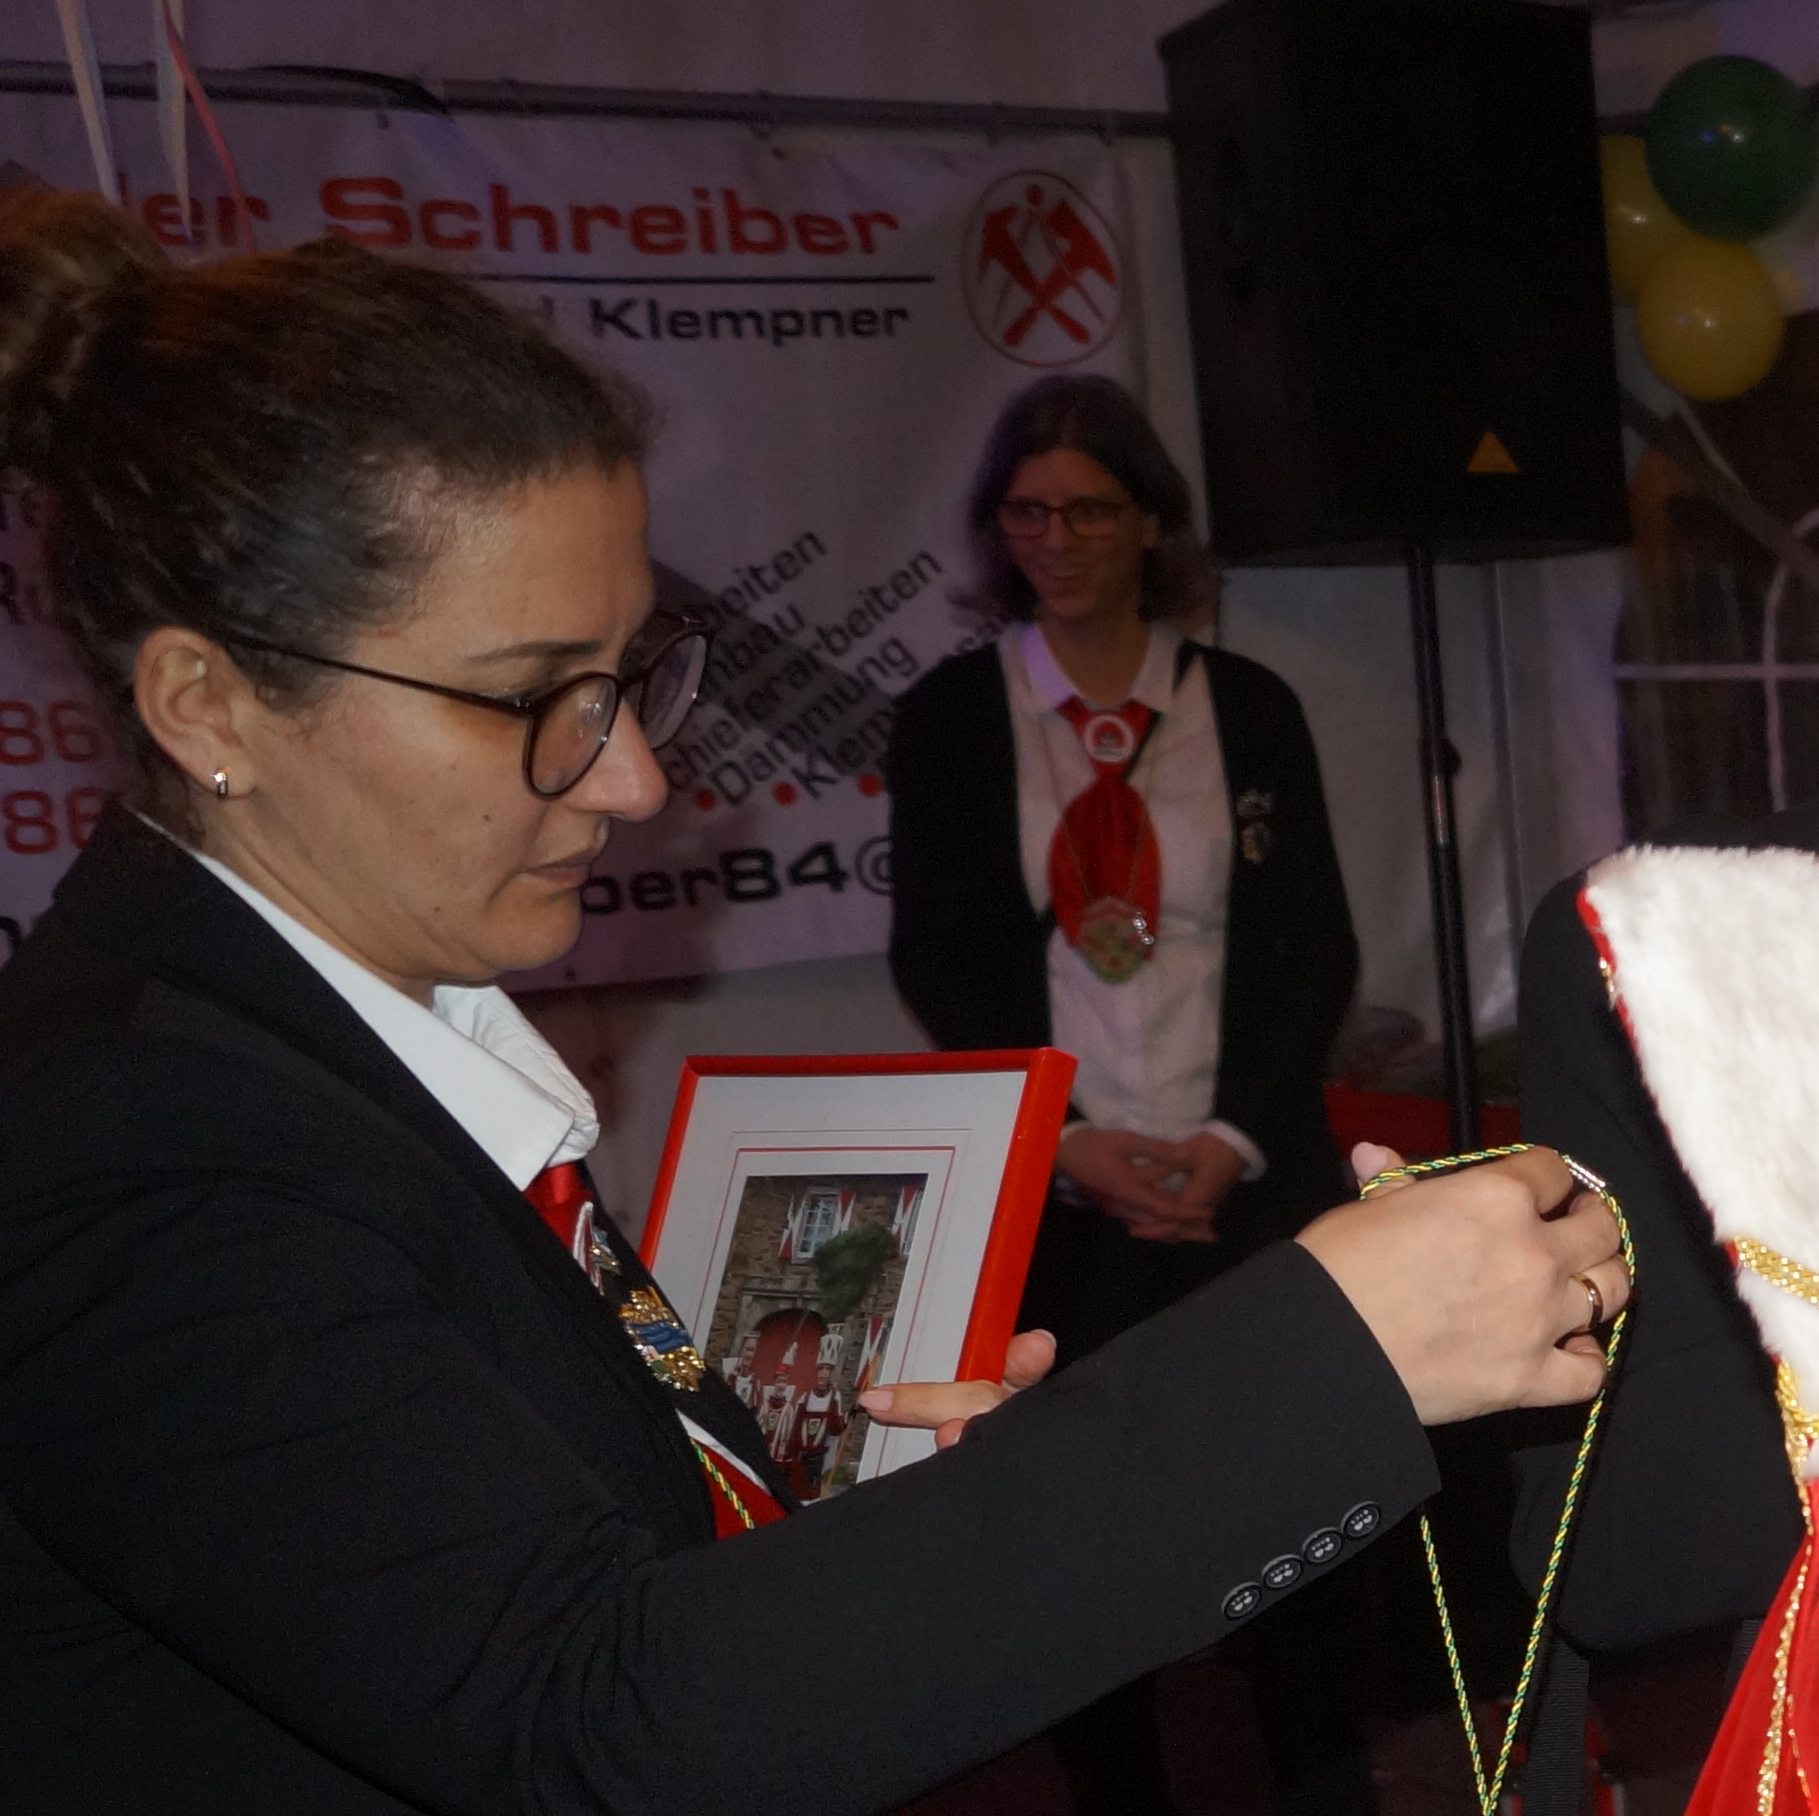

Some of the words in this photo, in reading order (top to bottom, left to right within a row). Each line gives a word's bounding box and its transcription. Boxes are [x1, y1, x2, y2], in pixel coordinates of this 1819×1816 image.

[117, 172, 269, 250] er
[319, 176, 900, 256] Schreiber
[589, 297, 909, 347] Klempner
[692, 603, 807, 705] nbau
